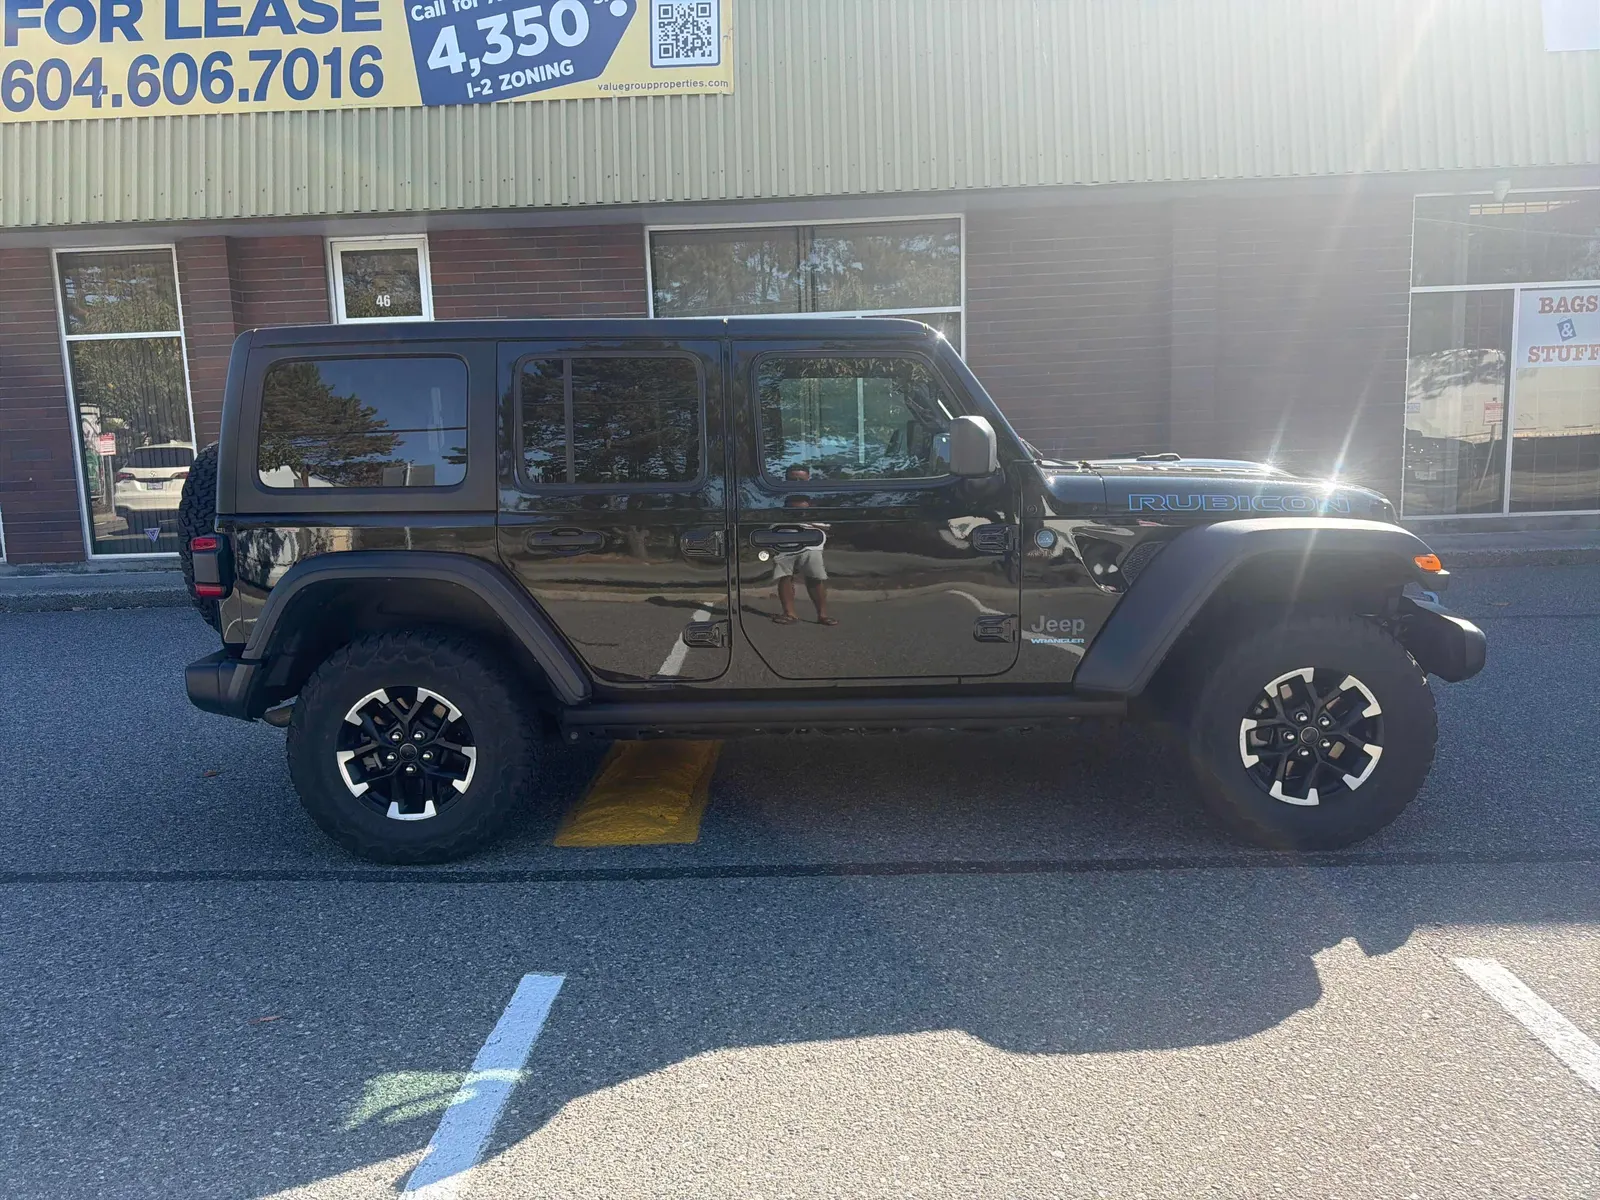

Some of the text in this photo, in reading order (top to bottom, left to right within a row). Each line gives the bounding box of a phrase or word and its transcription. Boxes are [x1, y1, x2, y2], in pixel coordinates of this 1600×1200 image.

[411, 0, 479, 21] Call for
[4, 0, 383, 47] FOR LEASE
[427, 0, 590, 77] 4,350
[1, 44, 384, 112] 604.606.7016
[466, 59, 575, 99] I-2 ZONING
[597, 79, 729, 92] valuegroupproperties.com
[376, 294, 391, 307] 46
[1538, 295, 1599, 314] BAGS
[1561, 322, 1574, 338] &
[1528, 344, 1600, 363] STUFF
[1128, 493, 1351, 513] RUBICON
[1031, 615, 1085, 635] Jeep
